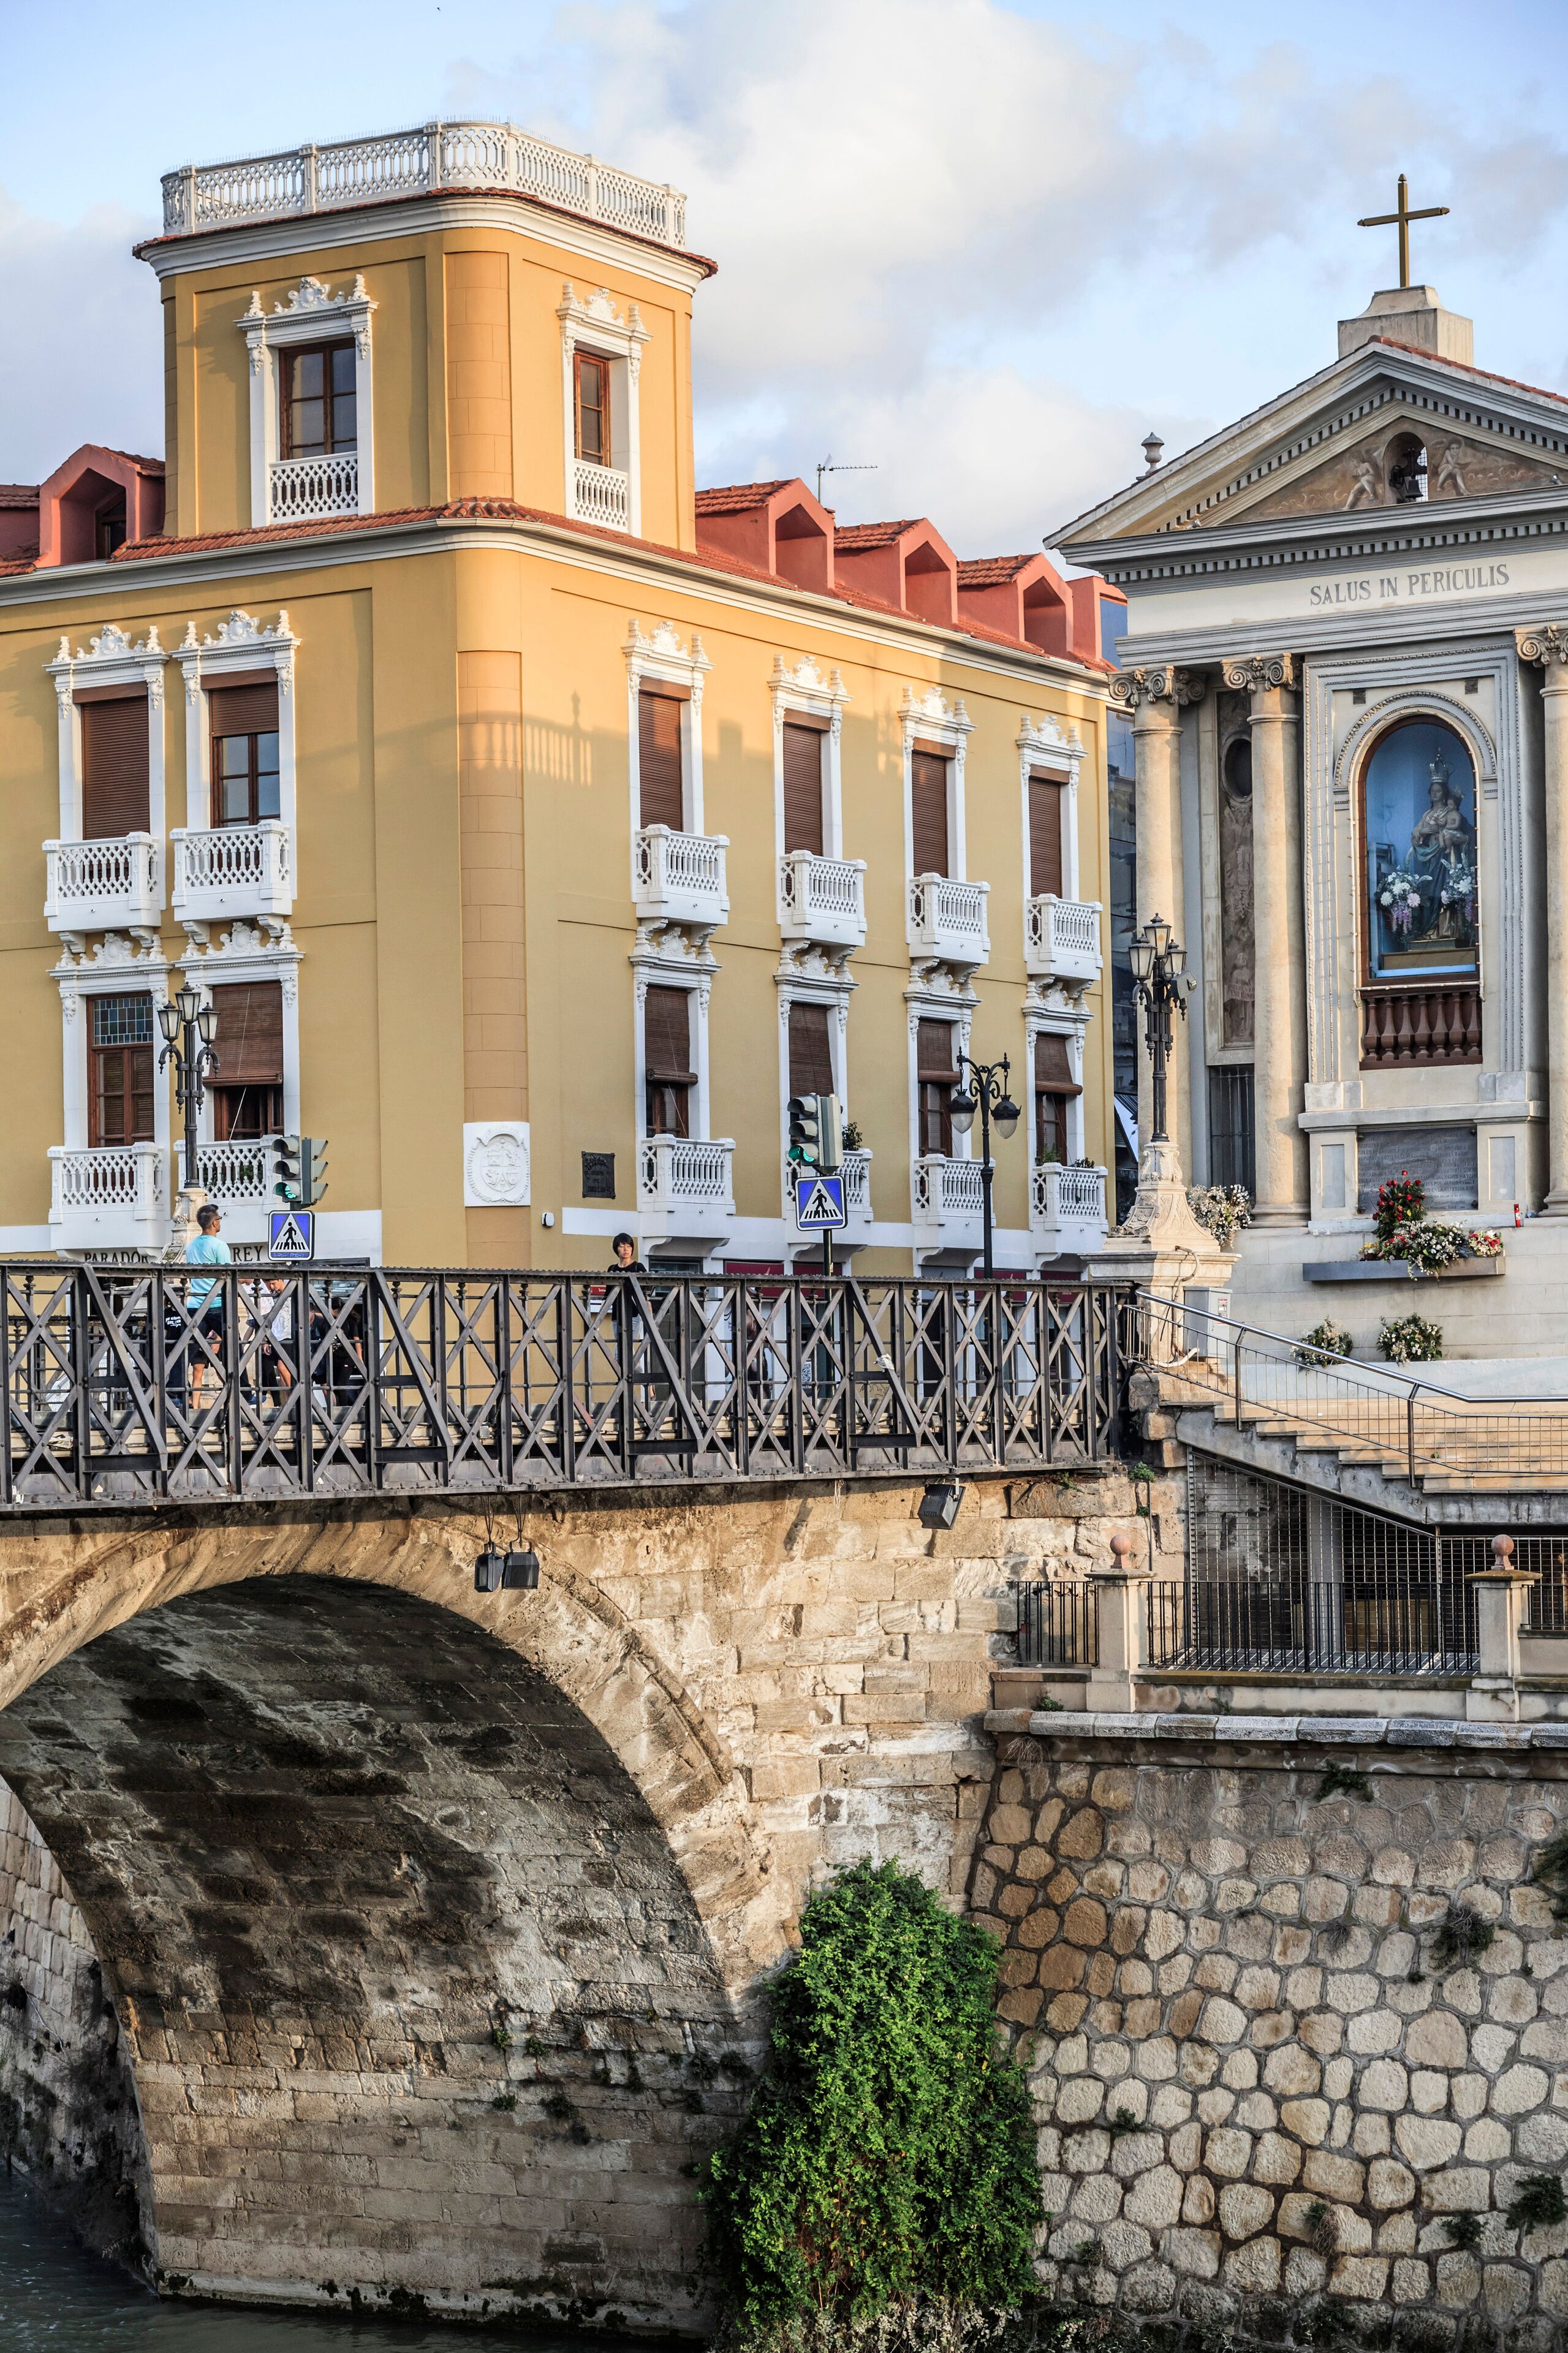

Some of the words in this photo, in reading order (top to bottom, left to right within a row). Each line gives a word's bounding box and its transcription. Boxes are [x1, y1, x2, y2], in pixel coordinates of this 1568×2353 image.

[1310, 580, 1371, 607] SALUS
[1379, 577, 1398, 598] IN
[233, 1246, 263, 1262] REY
